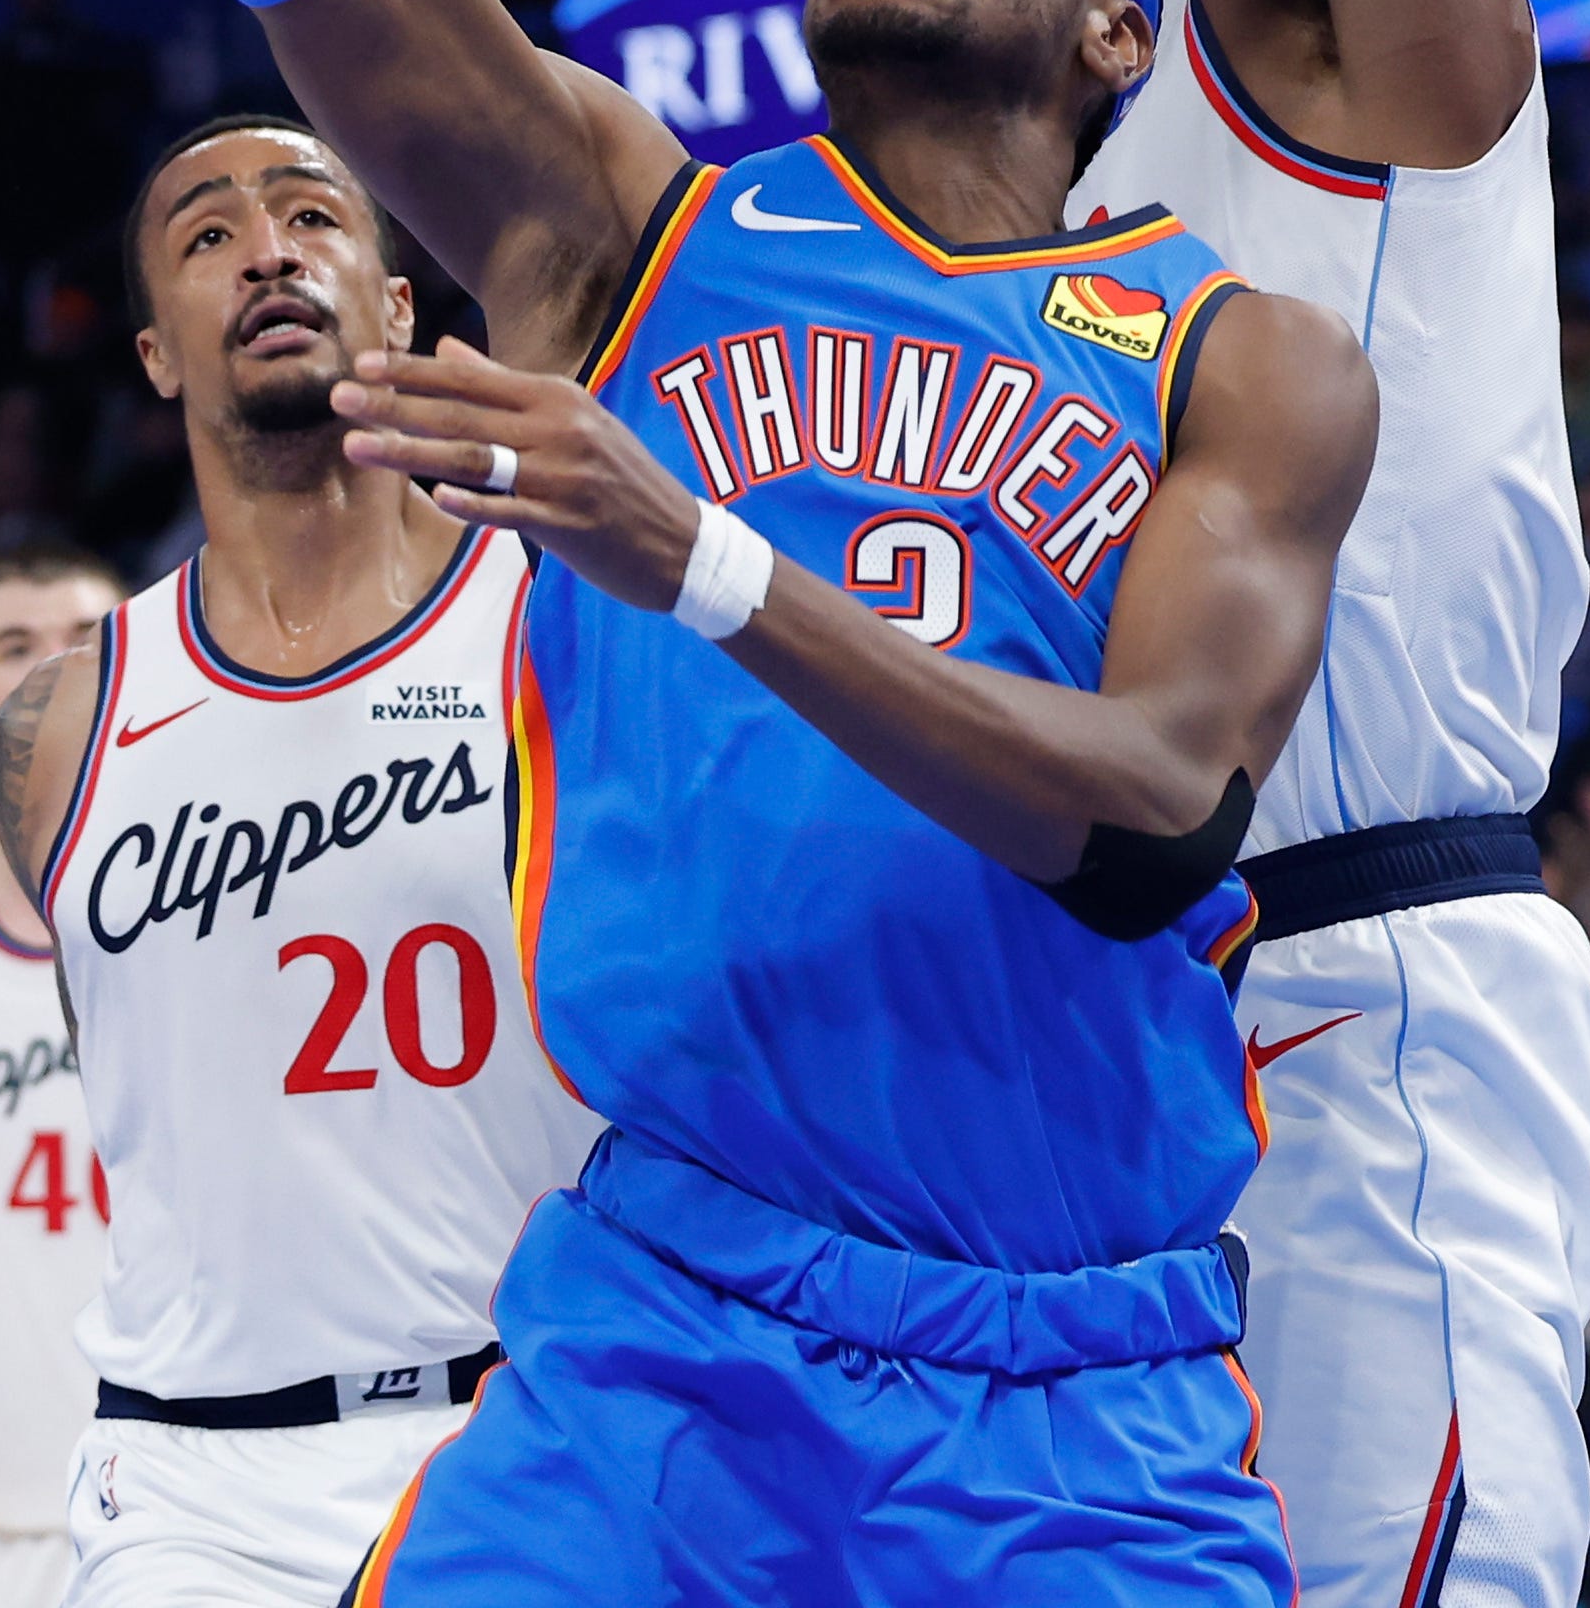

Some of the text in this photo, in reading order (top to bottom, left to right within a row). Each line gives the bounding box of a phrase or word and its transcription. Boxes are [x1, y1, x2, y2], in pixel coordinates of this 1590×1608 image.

[651, 325, 1159, 599] THUNDER
[371, 704, 487, 720] RWANDA
[397, 686, 463, 701] VISIT
[87, 740, 494, 954] Clippers
[277, 922, 498, 1095] 20
[6, 1129, 111, 1234] 4
